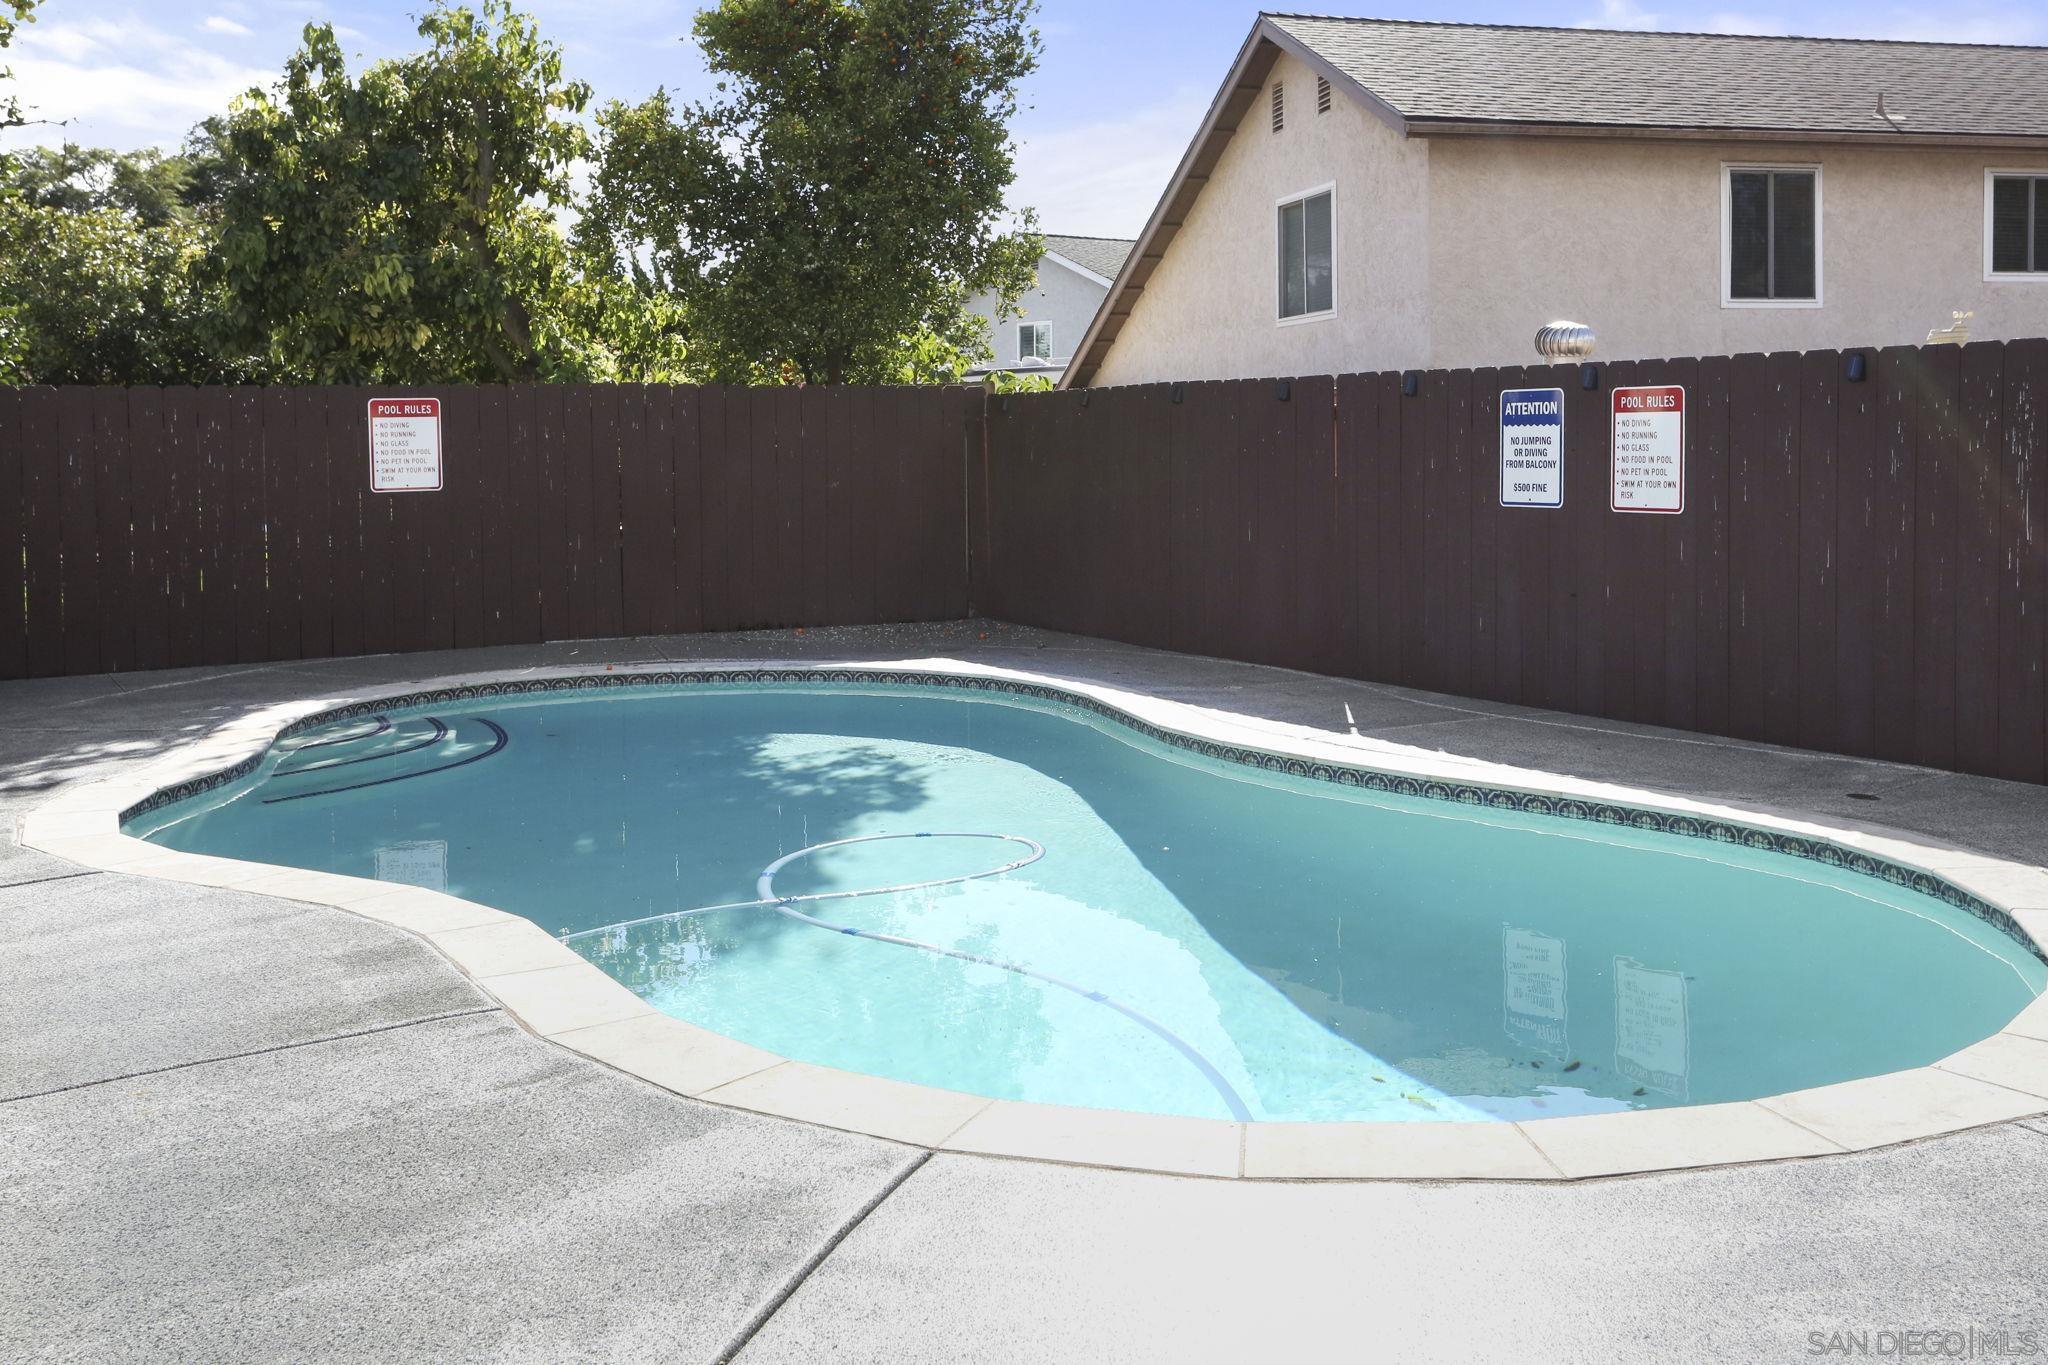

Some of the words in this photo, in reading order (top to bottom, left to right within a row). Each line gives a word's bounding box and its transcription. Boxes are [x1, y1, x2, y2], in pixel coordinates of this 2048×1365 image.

[1621, 397, 1643, 408] POOL
[1647, 396, 1675, 407] RULES
[378, 406, 401, 414] POOL
[405, 405, 431, 414] RULES
[1505, 401, 1558, 415] ATTENTION
[1510, 437, 1519, 445] NO
[1521, 437, 1552, 445] JUMPING
[1514, 449, 1523, 457] OR
[1525, 449, 1548, 457] DIVING
[1506, 460, 1524, 469] FROM
[1526, 460, 1557, 468] BALCONY
[1657, 456, 1673, 464] POOL
[1514, 483, 1530, 492] $500
[1532, 484, 1547, 492] FINE
